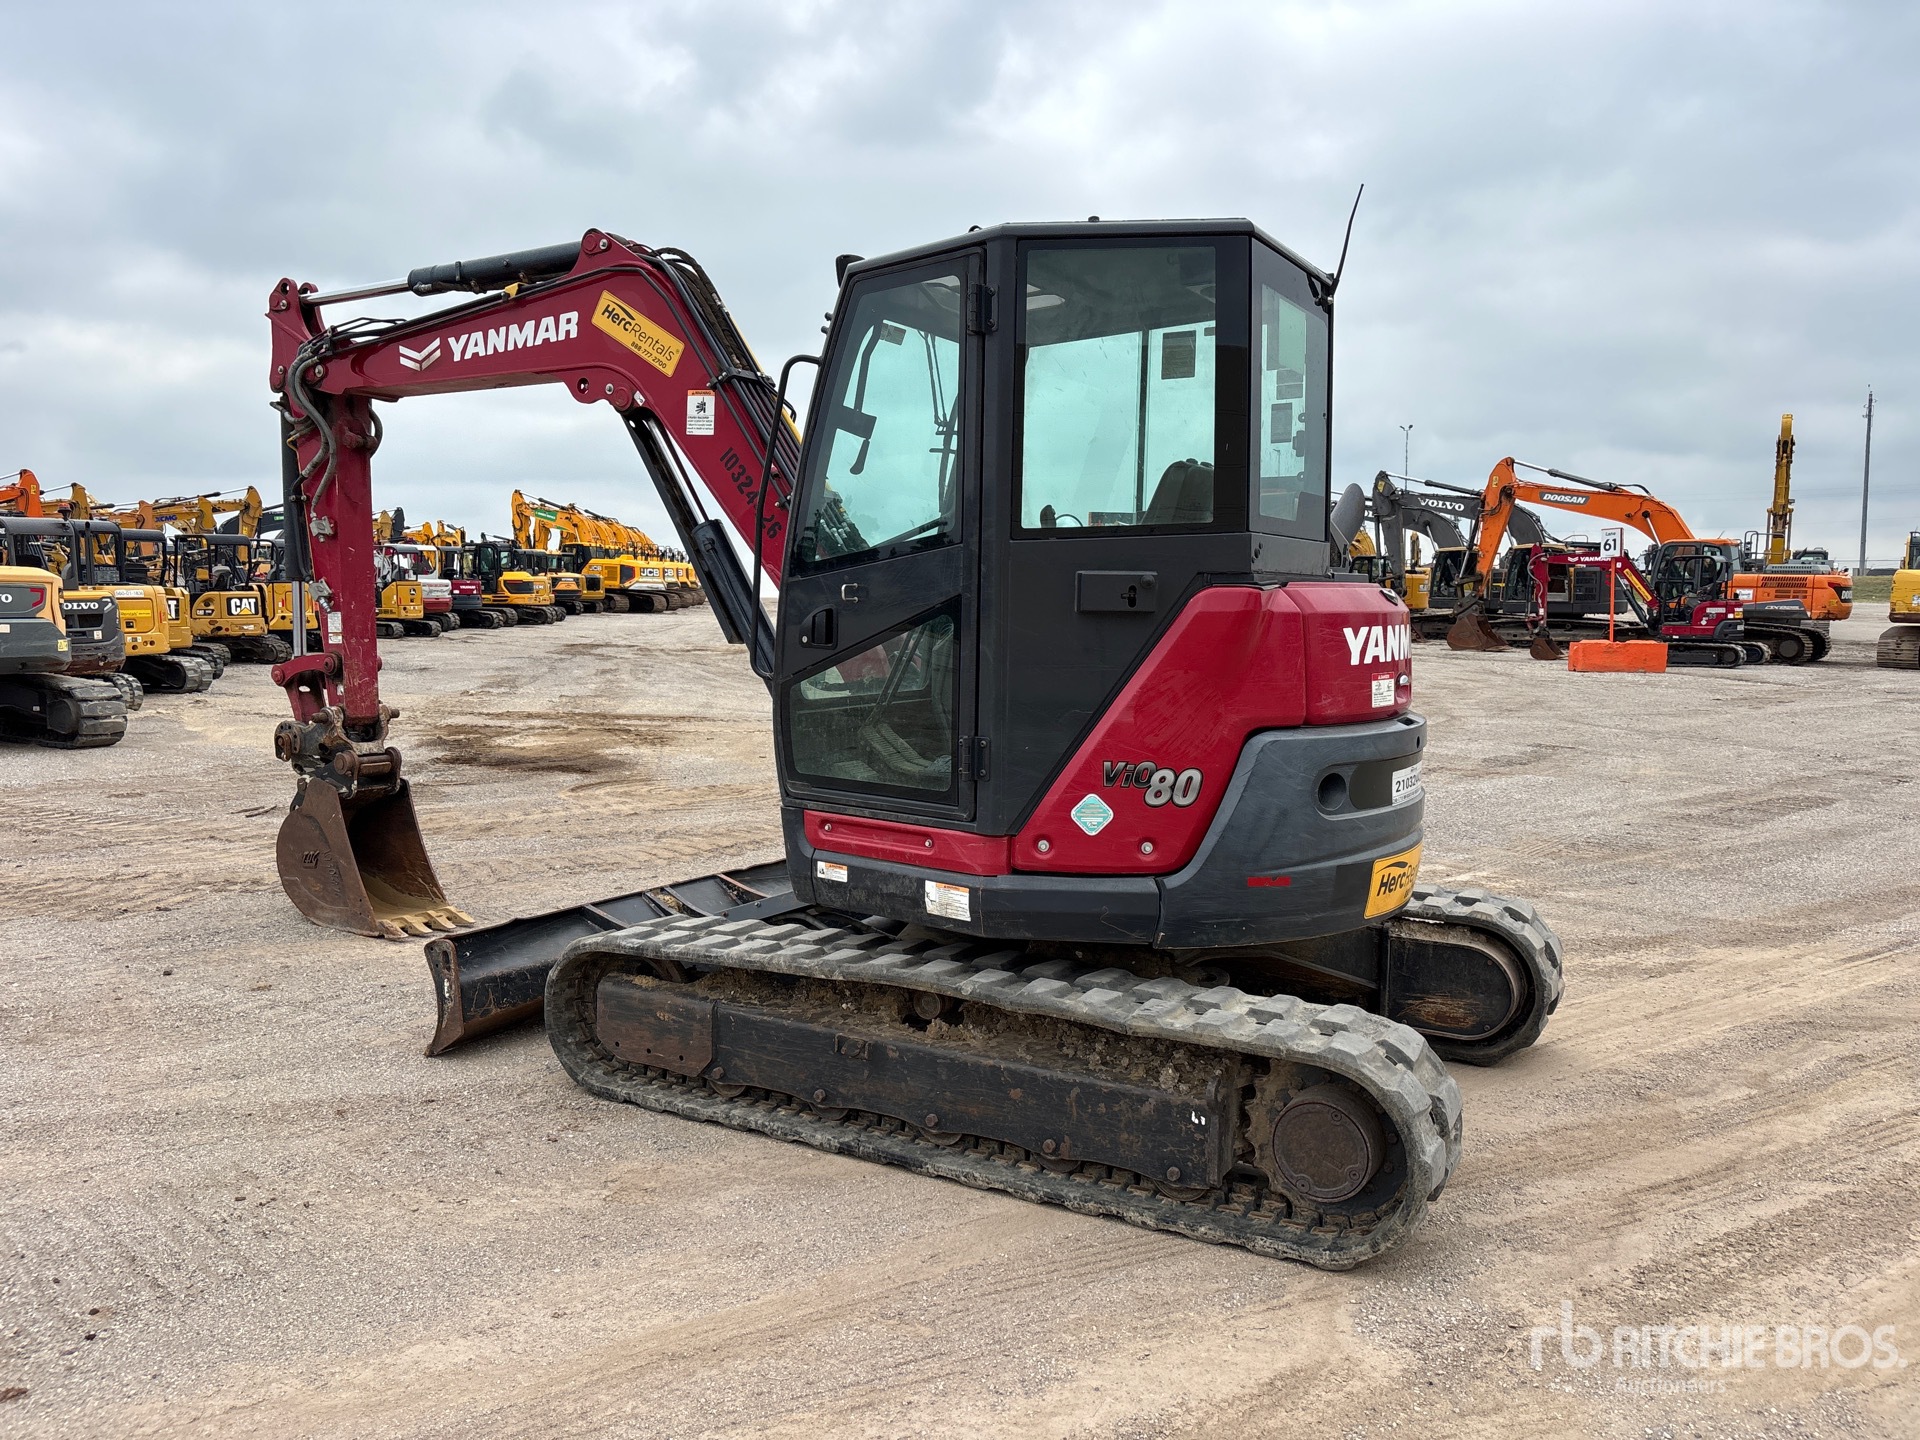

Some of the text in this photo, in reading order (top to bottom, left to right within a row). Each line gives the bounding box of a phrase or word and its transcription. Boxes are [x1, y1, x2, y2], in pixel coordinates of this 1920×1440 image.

[447, 311, 579, 362] YANMAR
[719, 447, 783, 539] 1032426
[1542, 493, 1586, 504] DOOSAN
[1417, 498, 1465, 511] VOLVO
[155, 514, 178, 522] XCMG
[1603, 538, 1617, 552] 61
[640, 568, 660, 577] JCB
[230, 598, 257, 615] CAT
